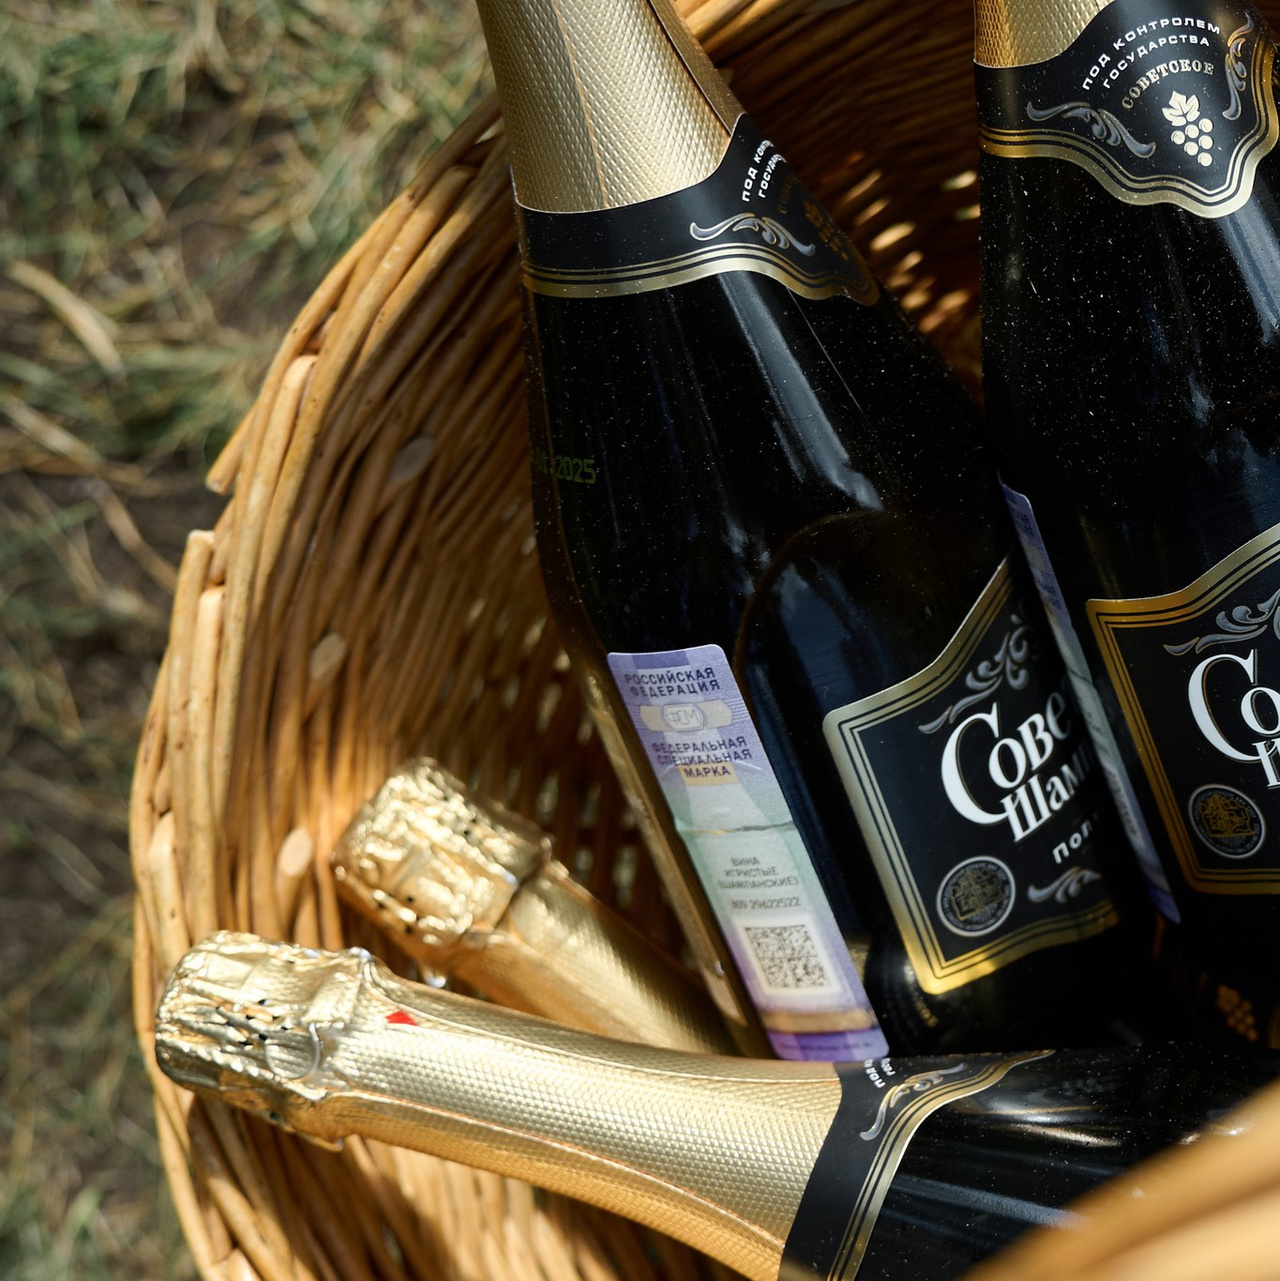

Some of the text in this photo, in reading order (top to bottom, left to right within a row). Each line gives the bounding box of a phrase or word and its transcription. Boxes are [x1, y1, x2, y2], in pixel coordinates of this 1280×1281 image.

[1082, 17, 1220, 91] ПОД КОНТРОЛЕМ
[1102, 34, 1210, 89] ГОСУДАРСТВА
[1121, 59, 1215, 109] СОВЕТСКОЕ
[742, 167, 758, 202] ПОД
[624, 667, 716, 686] РОССИЙСКАЯ
[630, 679, 721, 697] ФЕДЕРАЦИЯ
[652, 736, 747, 754] ФЕДЕРАЛЬНАЯ
[657, 749, 753, 767] СПЕЦИАЛЬНАЯ
[684, 765, 731, 779] МАРКА
[731, 856, 760, 867] ВИНА
[724, 866, 779, 878] ИГРИСТЫЕ
